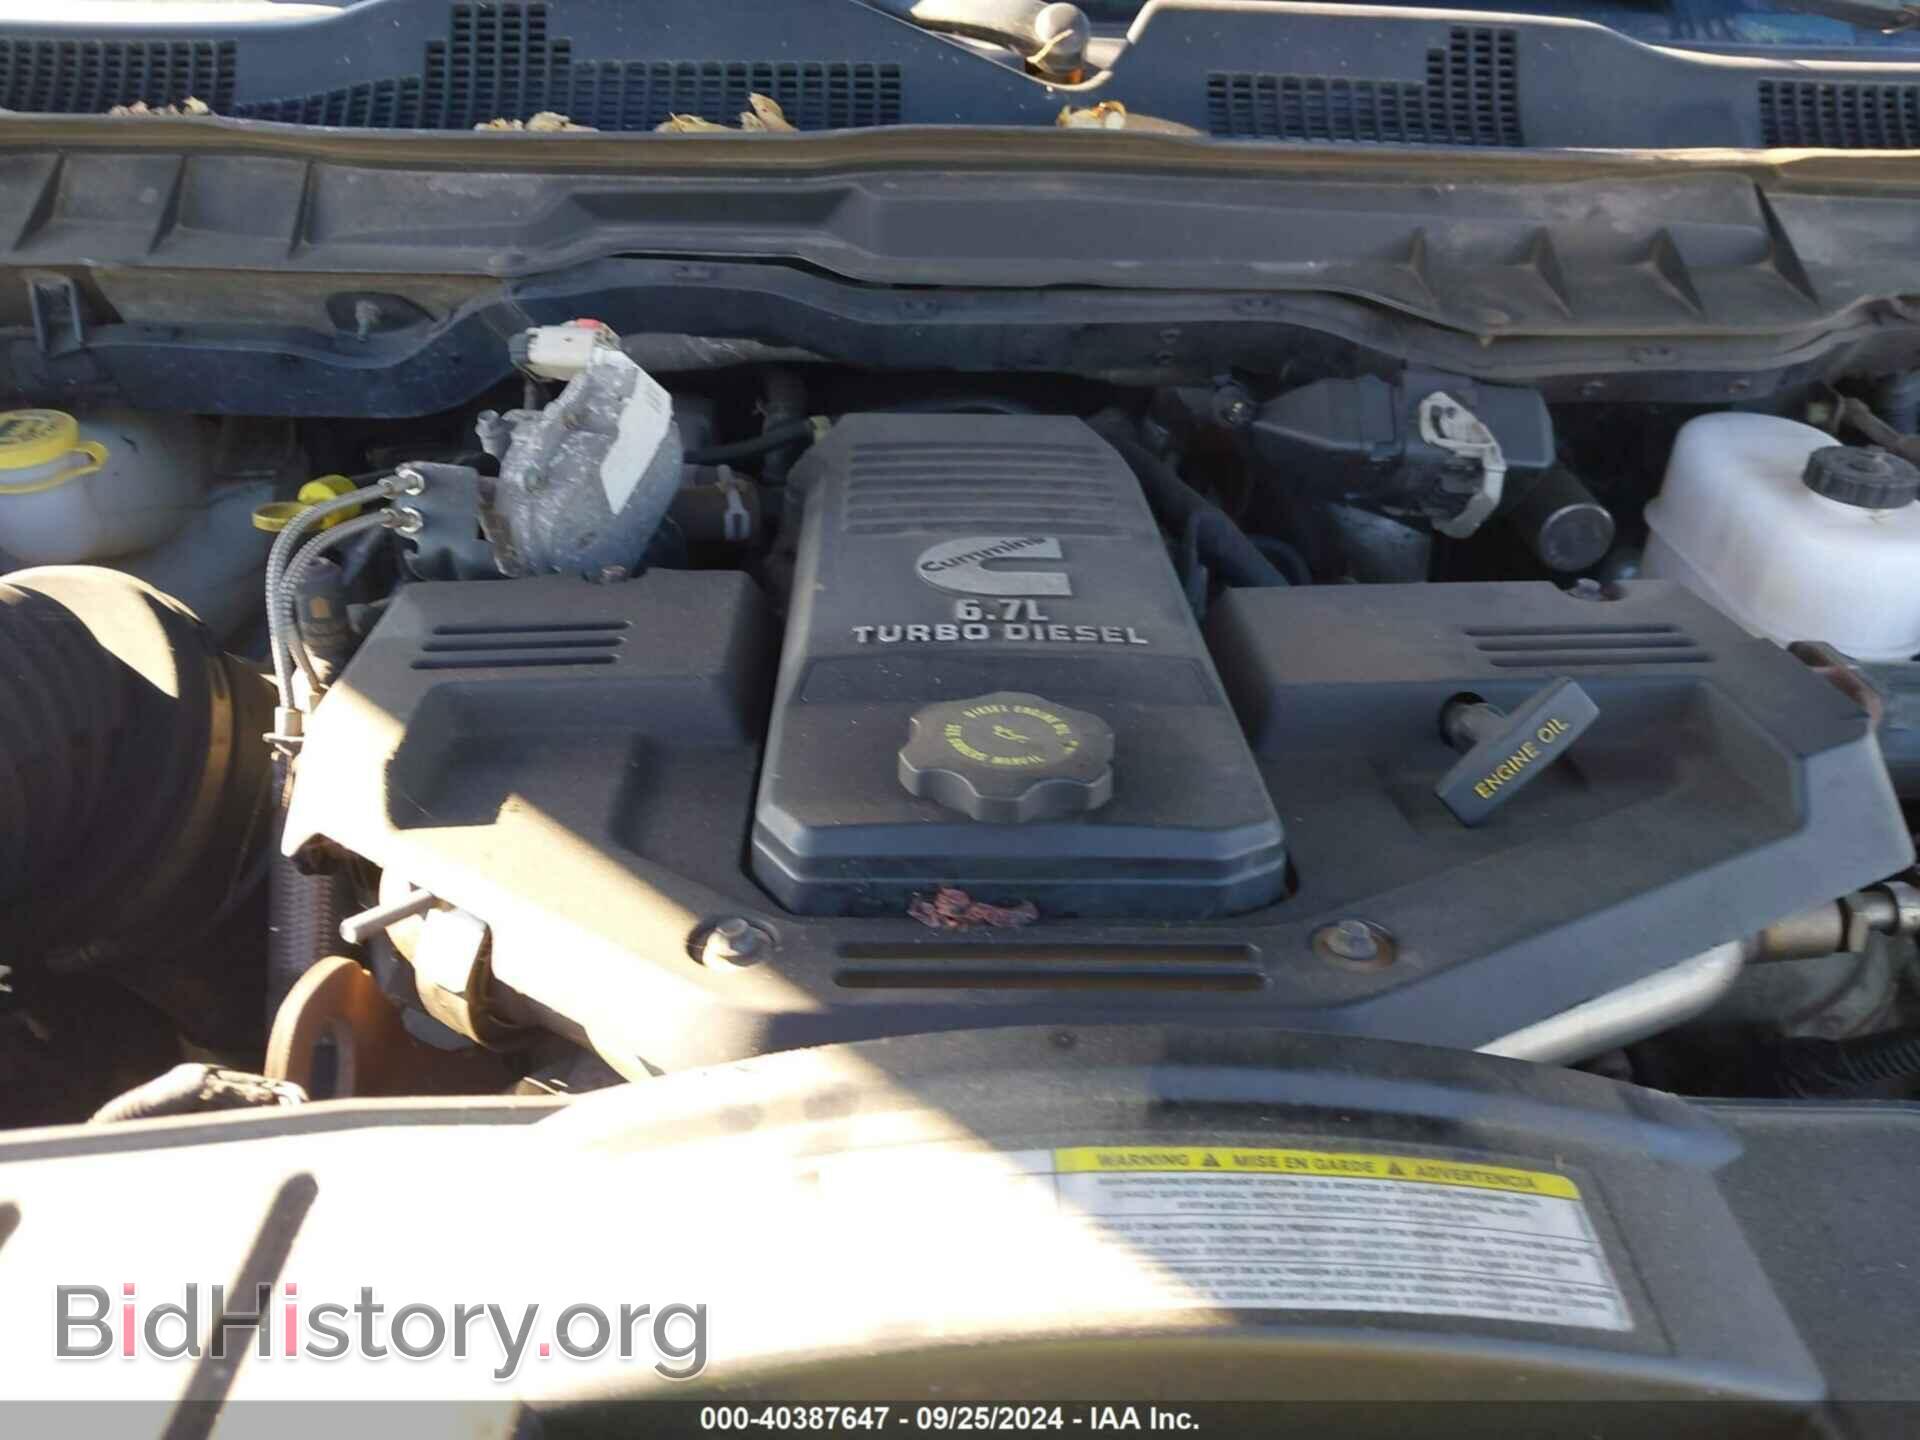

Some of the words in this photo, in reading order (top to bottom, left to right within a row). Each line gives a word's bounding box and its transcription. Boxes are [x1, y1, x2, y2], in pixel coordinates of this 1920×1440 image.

[920, 536, 1047, 573] Cummins
[955, 599, 1049, 622] 6.7L
[851, 624, 990, 644] TURBO
[1004, 624, 1149, 645] DIESEL
[1473, 741, 1540, 799] ENGINE
[1537, 718, 1570, 744] OIL
[1097, 1153, 1190, 1166] WARNING
[1232, 1154, 1279, 1167] MISE
[1284, 1156, 1308, 1168] EN
[1314, 1157, 1376, 1172] GARDE
[1415, 1164, 1538, 1189] ADVERTENCIA
